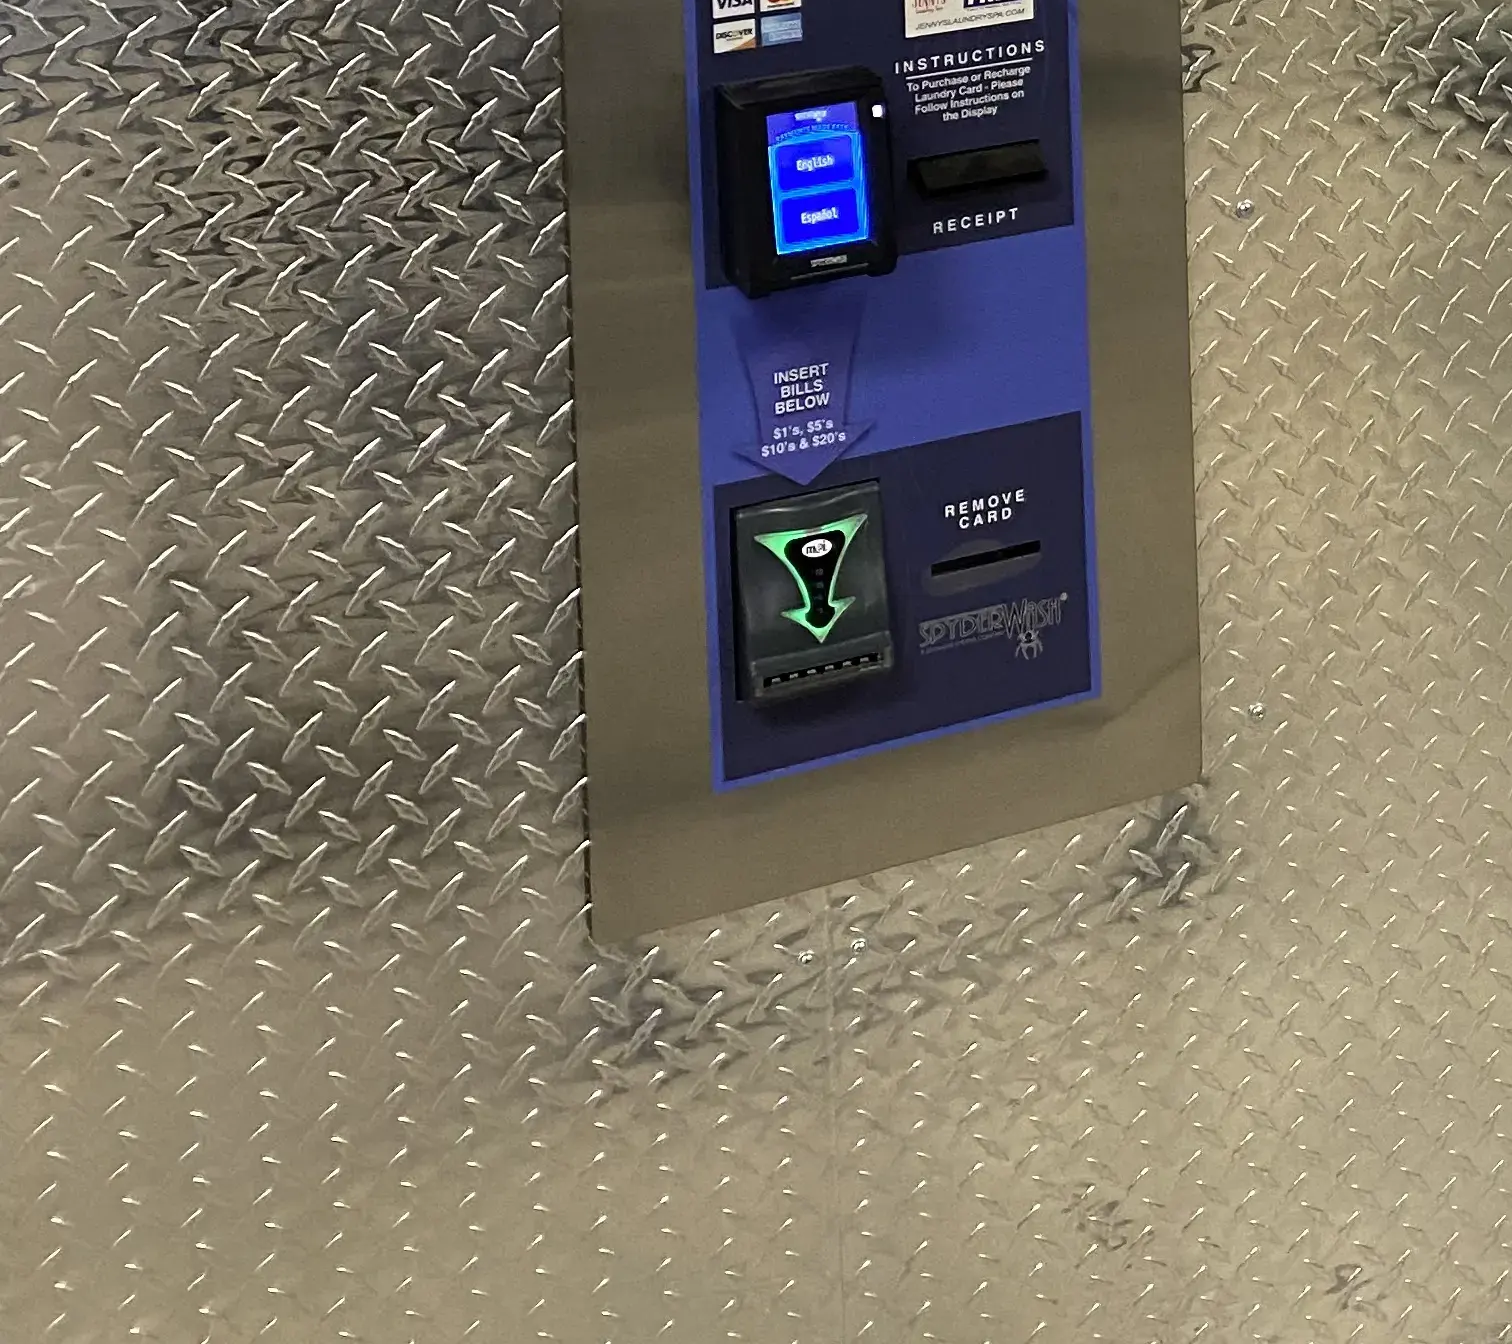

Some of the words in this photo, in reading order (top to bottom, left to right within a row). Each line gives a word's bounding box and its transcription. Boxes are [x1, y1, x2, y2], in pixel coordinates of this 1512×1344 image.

[895, 39, 1045, 74] INSTRUCTIONS
[906, 81, 919, 92] To
[922, 75, 968, 90] Purchase
[970, 73, 981, 82] or
[984, 65, 1031, 81] Recharge
[915, 87, 956, 103] Laundry
[958, 84, 983, 96] Card
[991, 78, 1024, 90] Please
[915, 99, 949, 115] Follow
[950, 91, 1009, 108] Instructions
[1011, 89, 1025, 99] on
[942, 111, 958, 121] the
[961, 105, 998, 119] Display
[796, 155, 835, 172] English
[801, 206, 839, 225] Español
[933, 207, 1018, 234] RECEIPT
[774, 362, 829, 385] INSERT
[780, 379, 824, 399] BILLS
[775, 392, 830, 414] BELOW
[773, 425, 804, 440] $1's,
[806, 419, 834, 433] $5's
[761, 441, 796, 458] $10's
[799, 438, 810, 450] &
[812, 431, 846, 447] $20's
[944, 489, 1025, 518] REMOVE
[959, 507, 1012, 529] CARD
